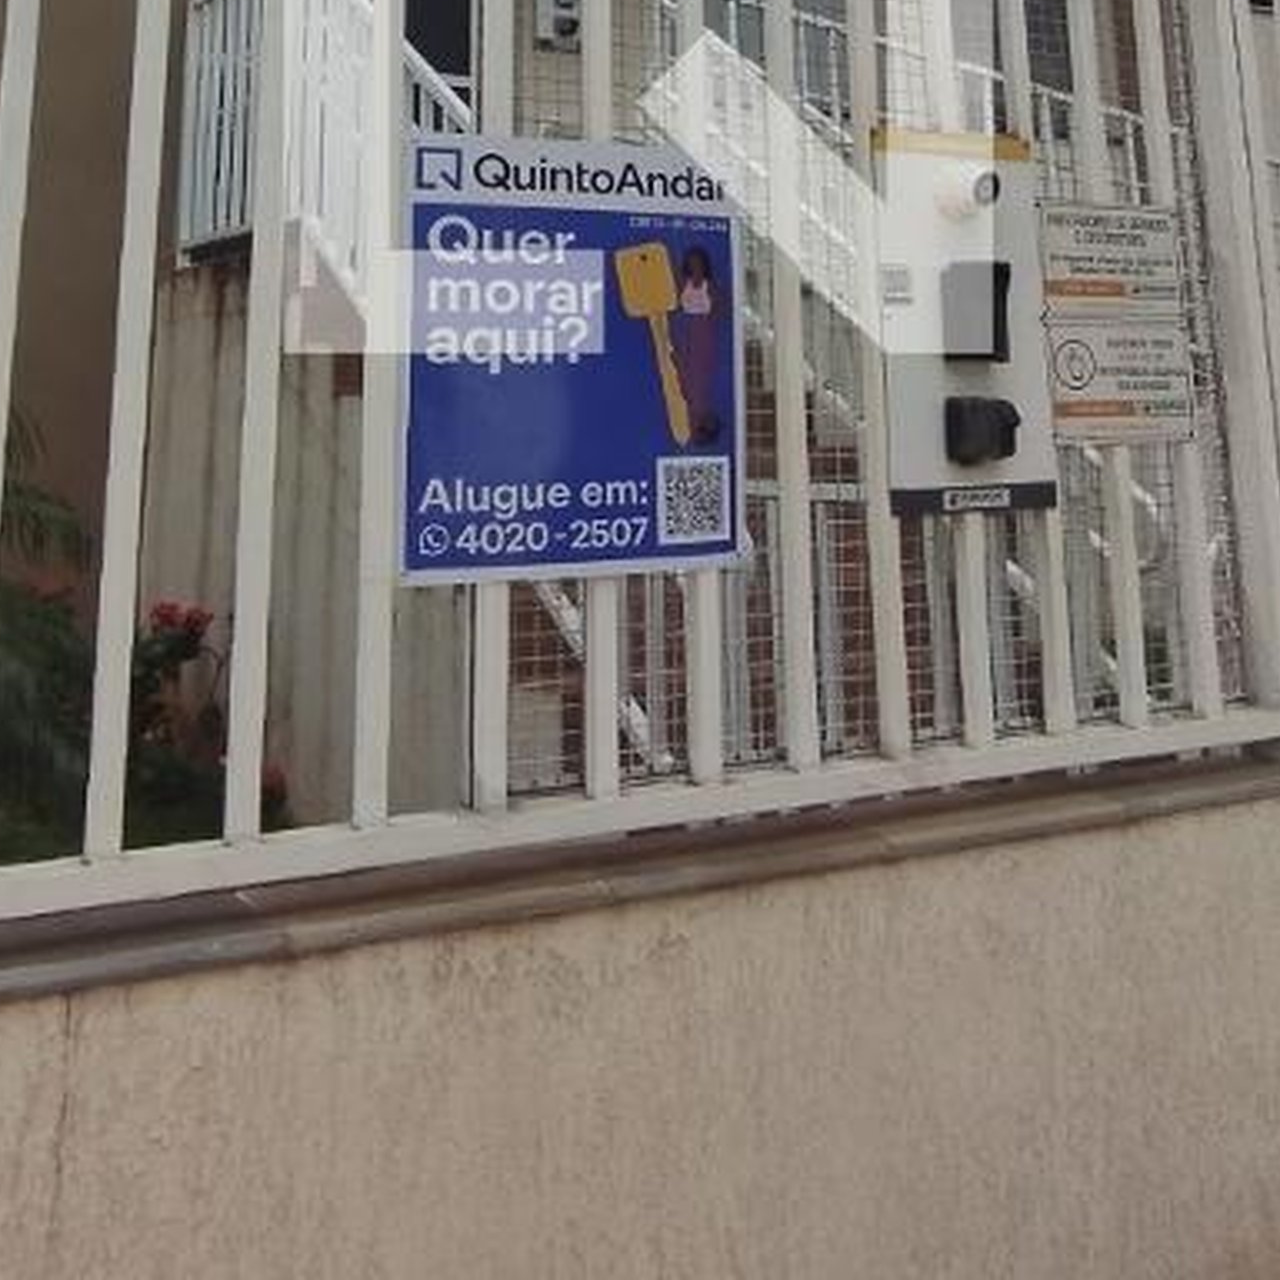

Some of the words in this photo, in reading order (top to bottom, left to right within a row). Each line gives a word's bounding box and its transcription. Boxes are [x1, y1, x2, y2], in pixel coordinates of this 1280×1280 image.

[428, 214, 576, 265] Quer
[428, 277, 602, 314] morar
[426, 316, 588, 374] aqui?
[420, 479, 570, 518] Alugue
[581, 480, 648, 507] em:
